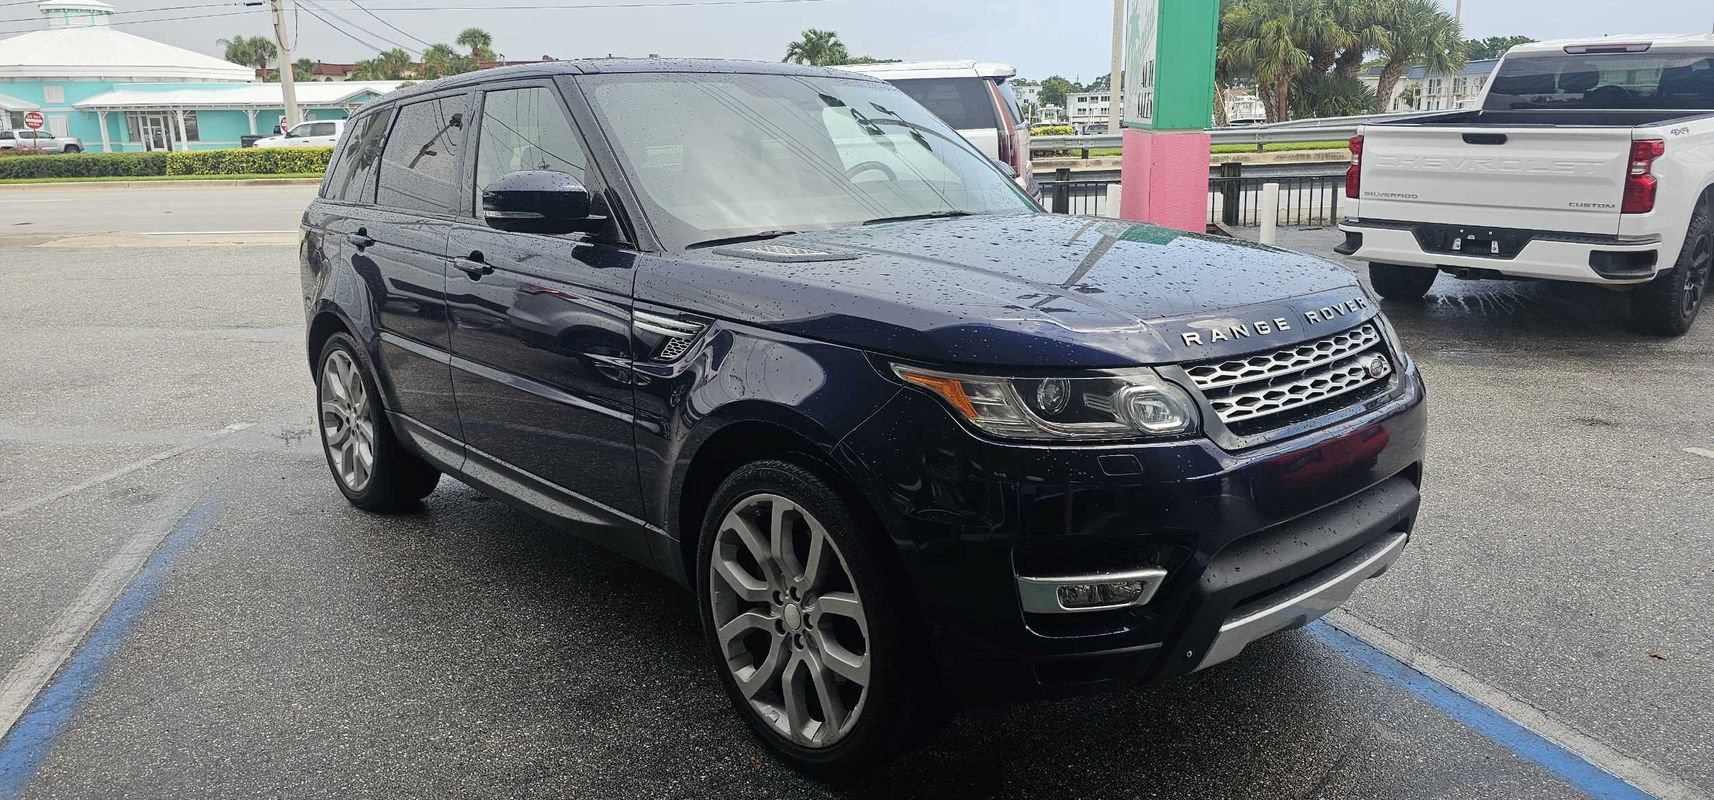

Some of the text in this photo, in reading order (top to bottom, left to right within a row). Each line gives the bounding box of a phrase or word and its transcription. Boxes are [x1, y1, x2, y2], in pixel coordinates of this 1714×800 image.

[1374, 153, 1607, 176] CHEVROLET
[1363, 190, 1419, 200] SILVERADO
[1568, 201, 1616, 210] CUSTOM
[1181, 297, 1368, 347] RANGE ROVER
